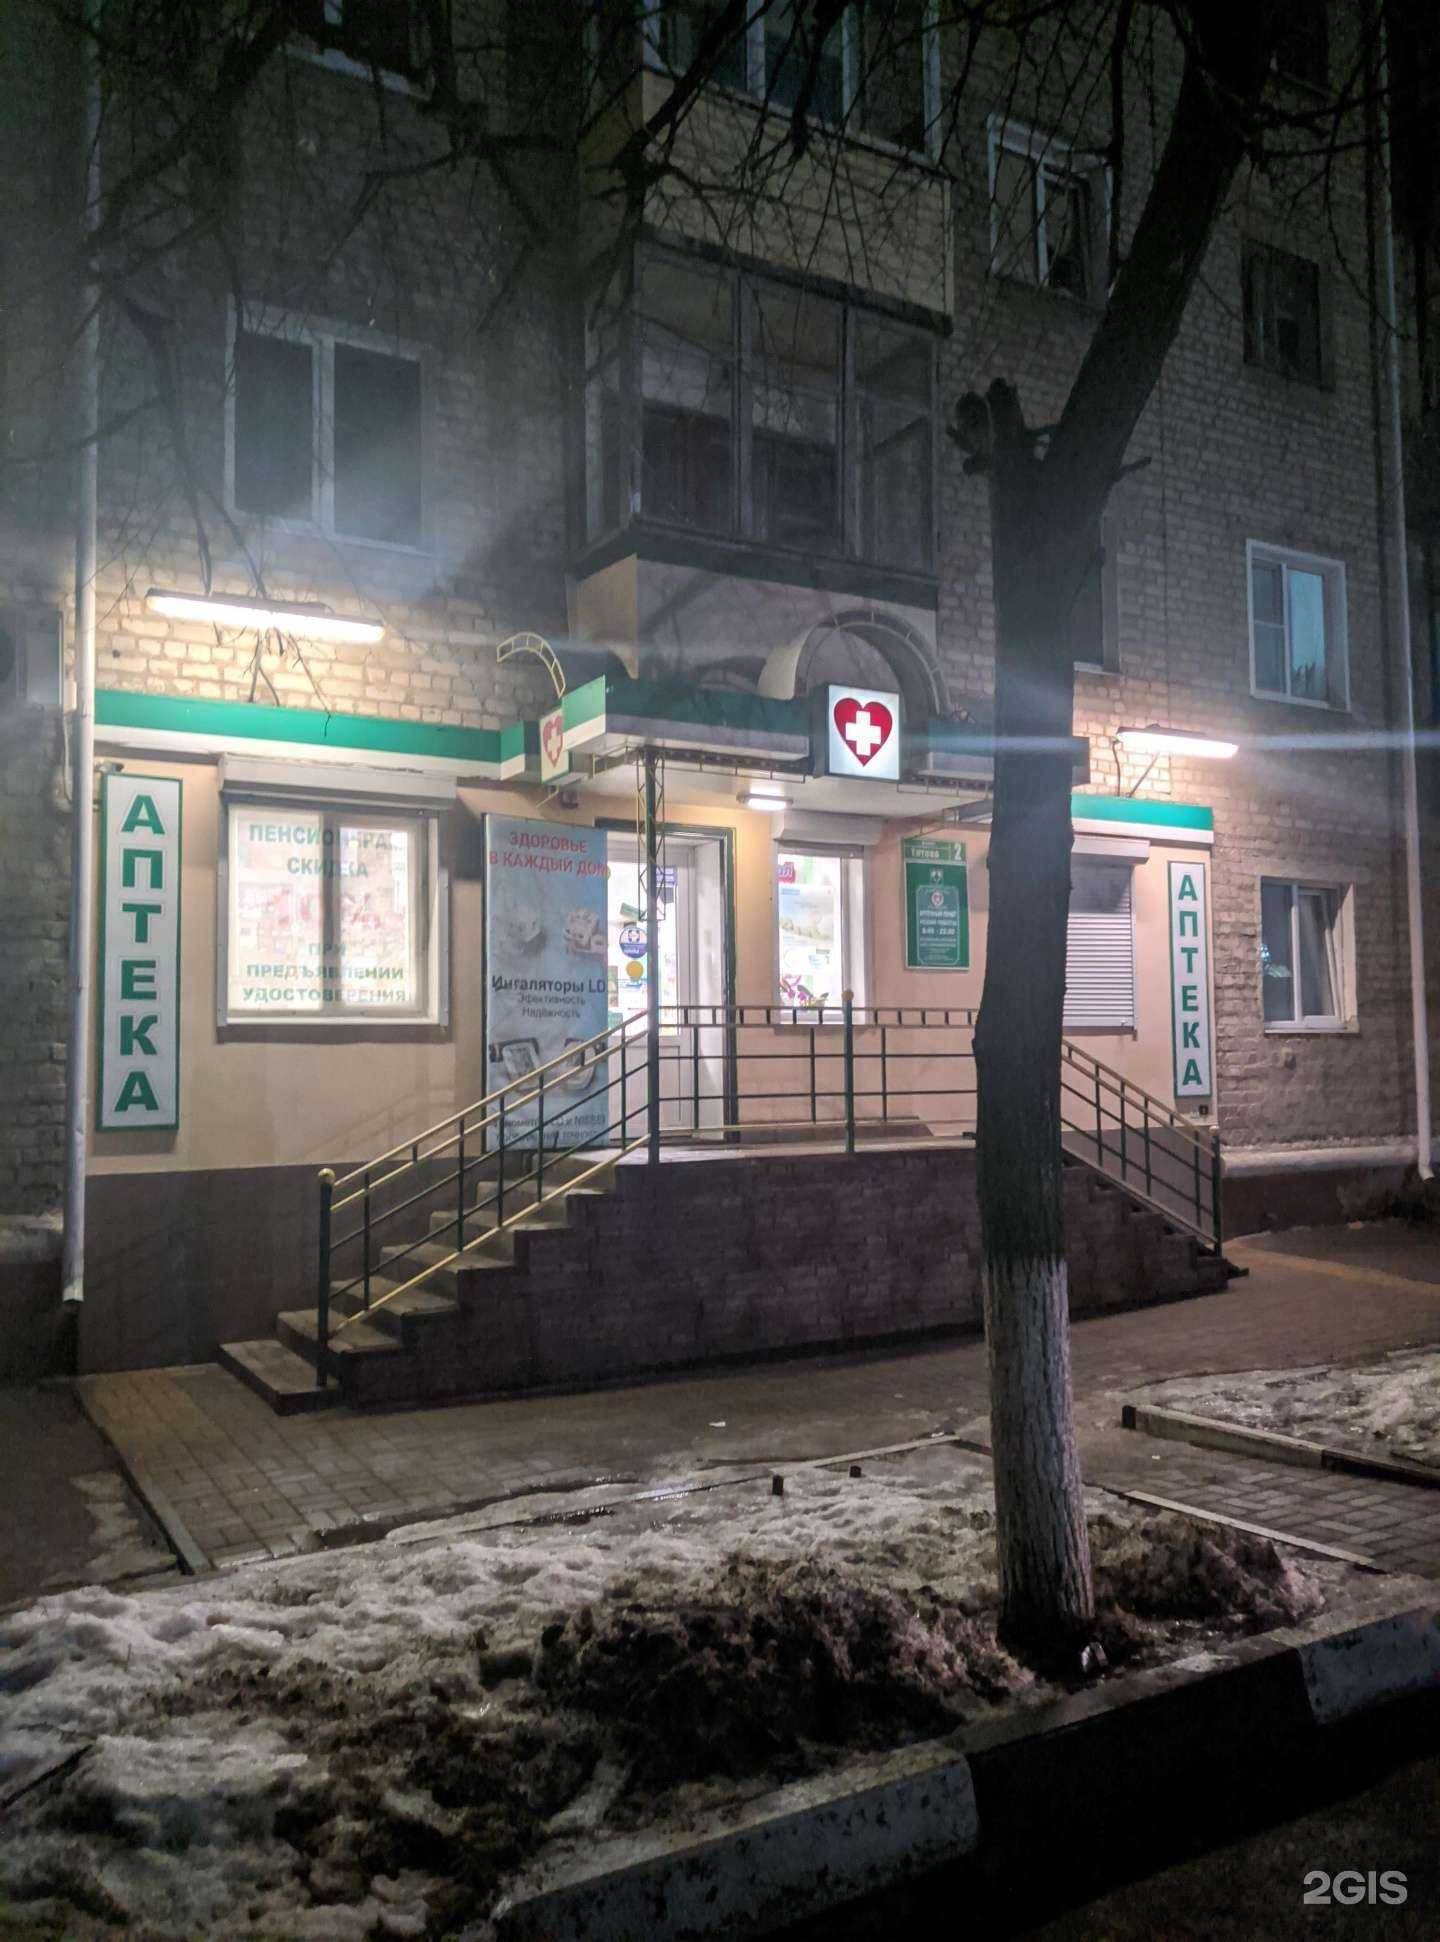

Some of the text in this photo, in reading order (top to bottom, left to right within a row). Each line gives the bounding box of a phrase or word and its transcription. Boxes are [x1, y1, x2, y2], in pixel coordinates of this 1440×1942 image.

[250, 824, 403, 850] ПЕНСИОРА
[510, 831, 588, 853] ЗДОРОВЬЕ
[954, 843, 962, 860] 2
[287, 857, 368, 879] СКИДКА
[490, 851, 608, 878] В КАЖДЫЙ ДОМ
[114, 794, 165, 1112] АПТЕКА
[492, 976, 583, 994] Ингаляторы
[1178, 874, 1203, 1087] АПТЕКА
